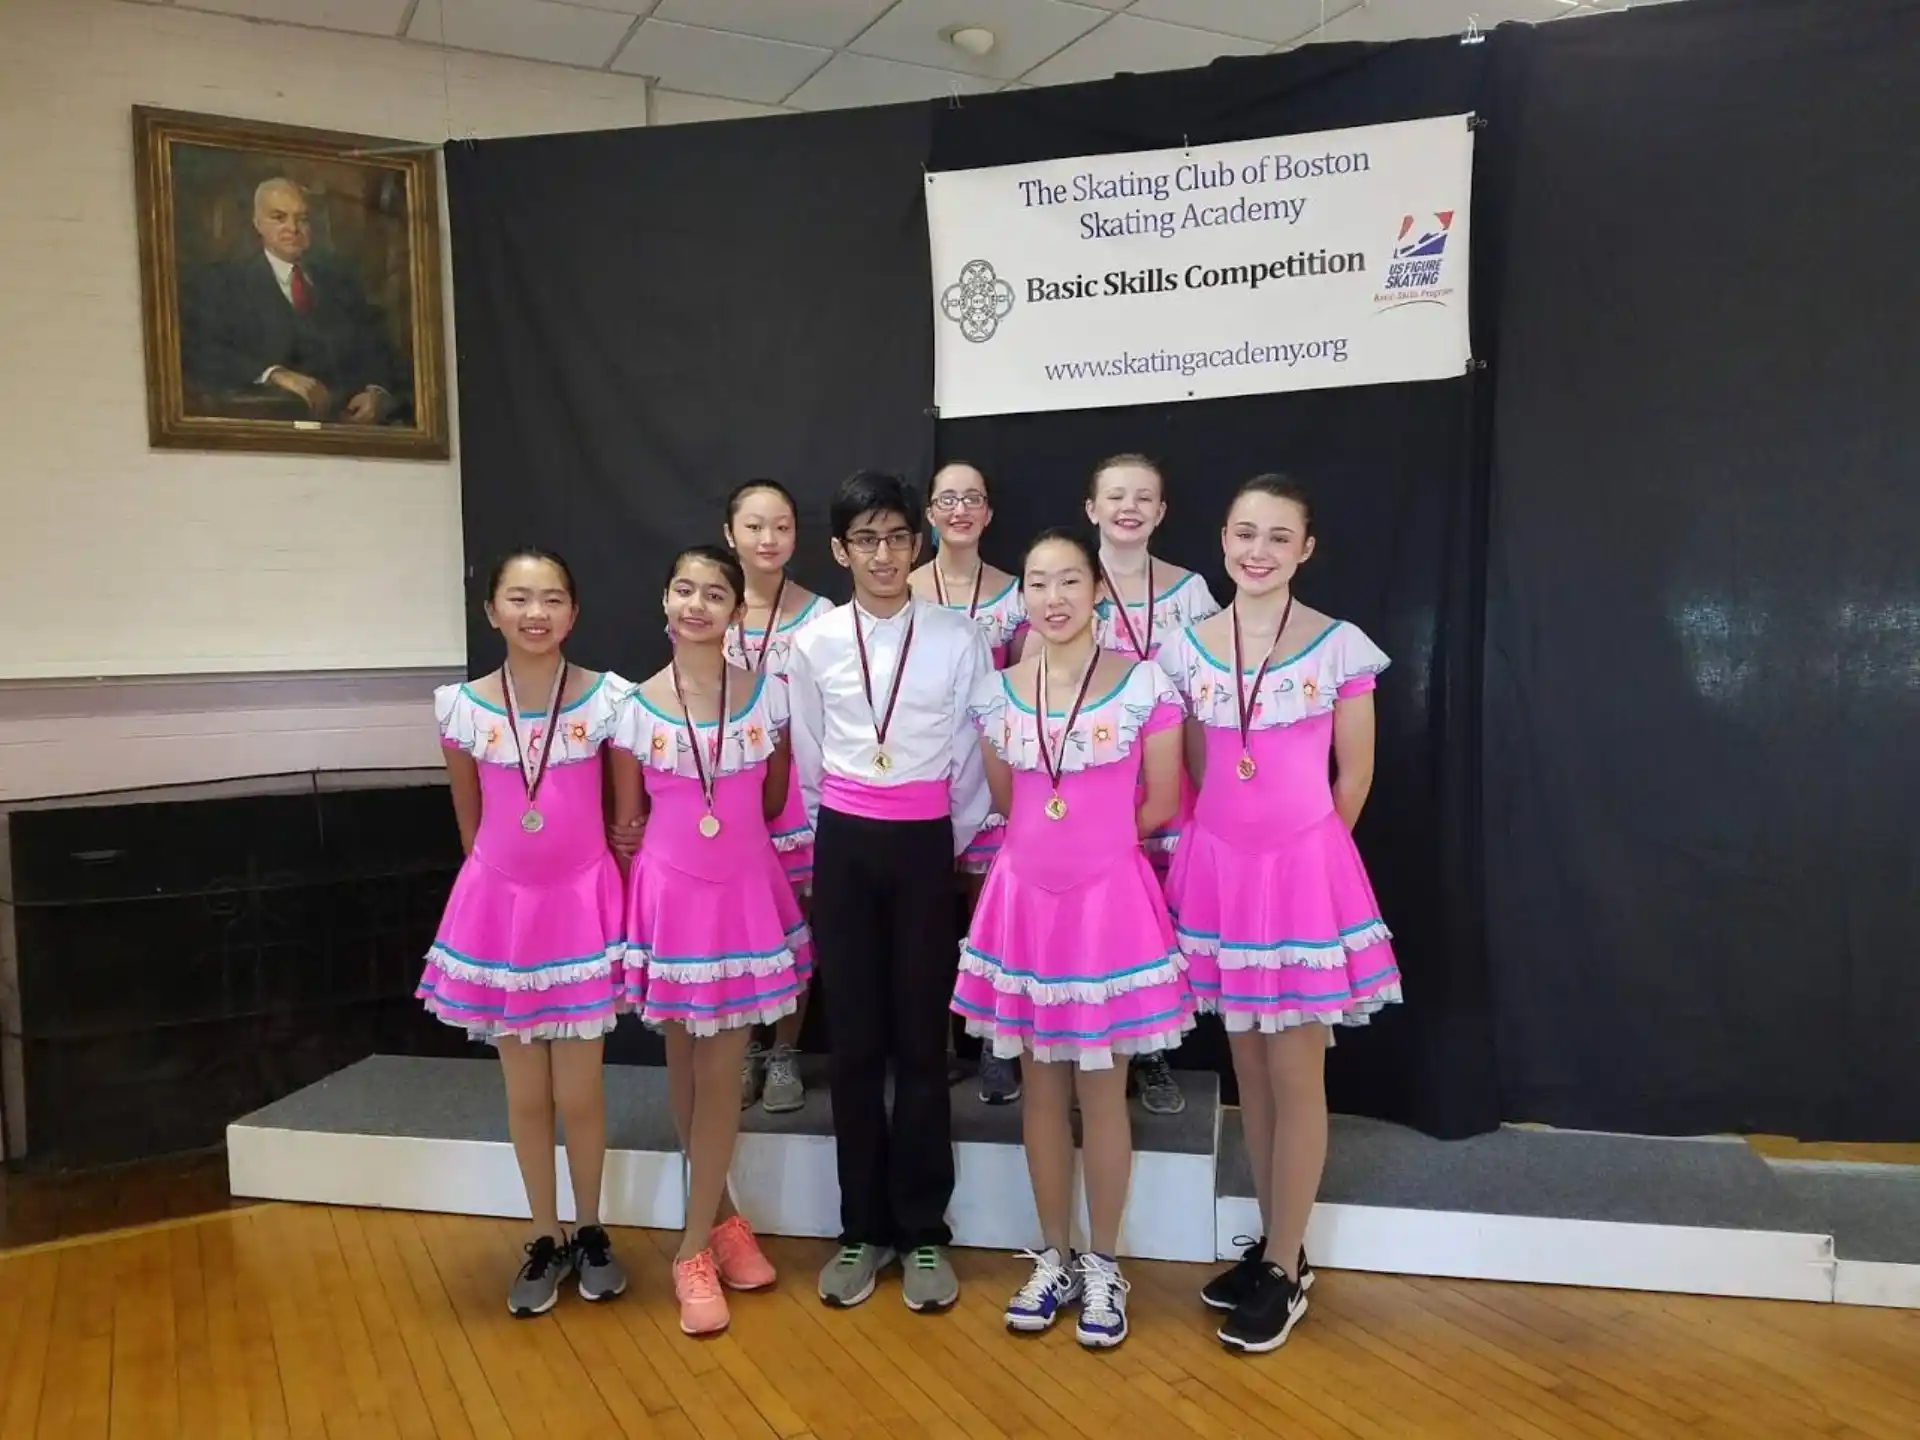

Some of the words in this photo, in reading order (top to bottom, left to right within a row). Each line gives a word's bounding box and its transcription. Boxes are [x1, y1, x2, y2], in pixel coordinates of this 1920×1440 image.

[1019, 179, 1067, 206] The
[1073, 171, 1170, 201] Skating
[1176, 161, 1235, 192] Club
[1242, 155, 1270, 185] of
[1275, 151, 1370, 181] Boston
[1080, 208, 1176, 239] Skating
[1180, 197, 1306, 229] Academy
[1026, 274, 1099, 302] Basic
[1103, 268, 1178, 296] Skills
[1185, 249, 1366, 289] Competition
[1385, 271, 1440, 289] SKATING
[1389, 261, 1403, 275] US
[1404, 258, 1443, 273] FIGURE
[1045, 337, 1348, 380] www.skatingacademy.org
